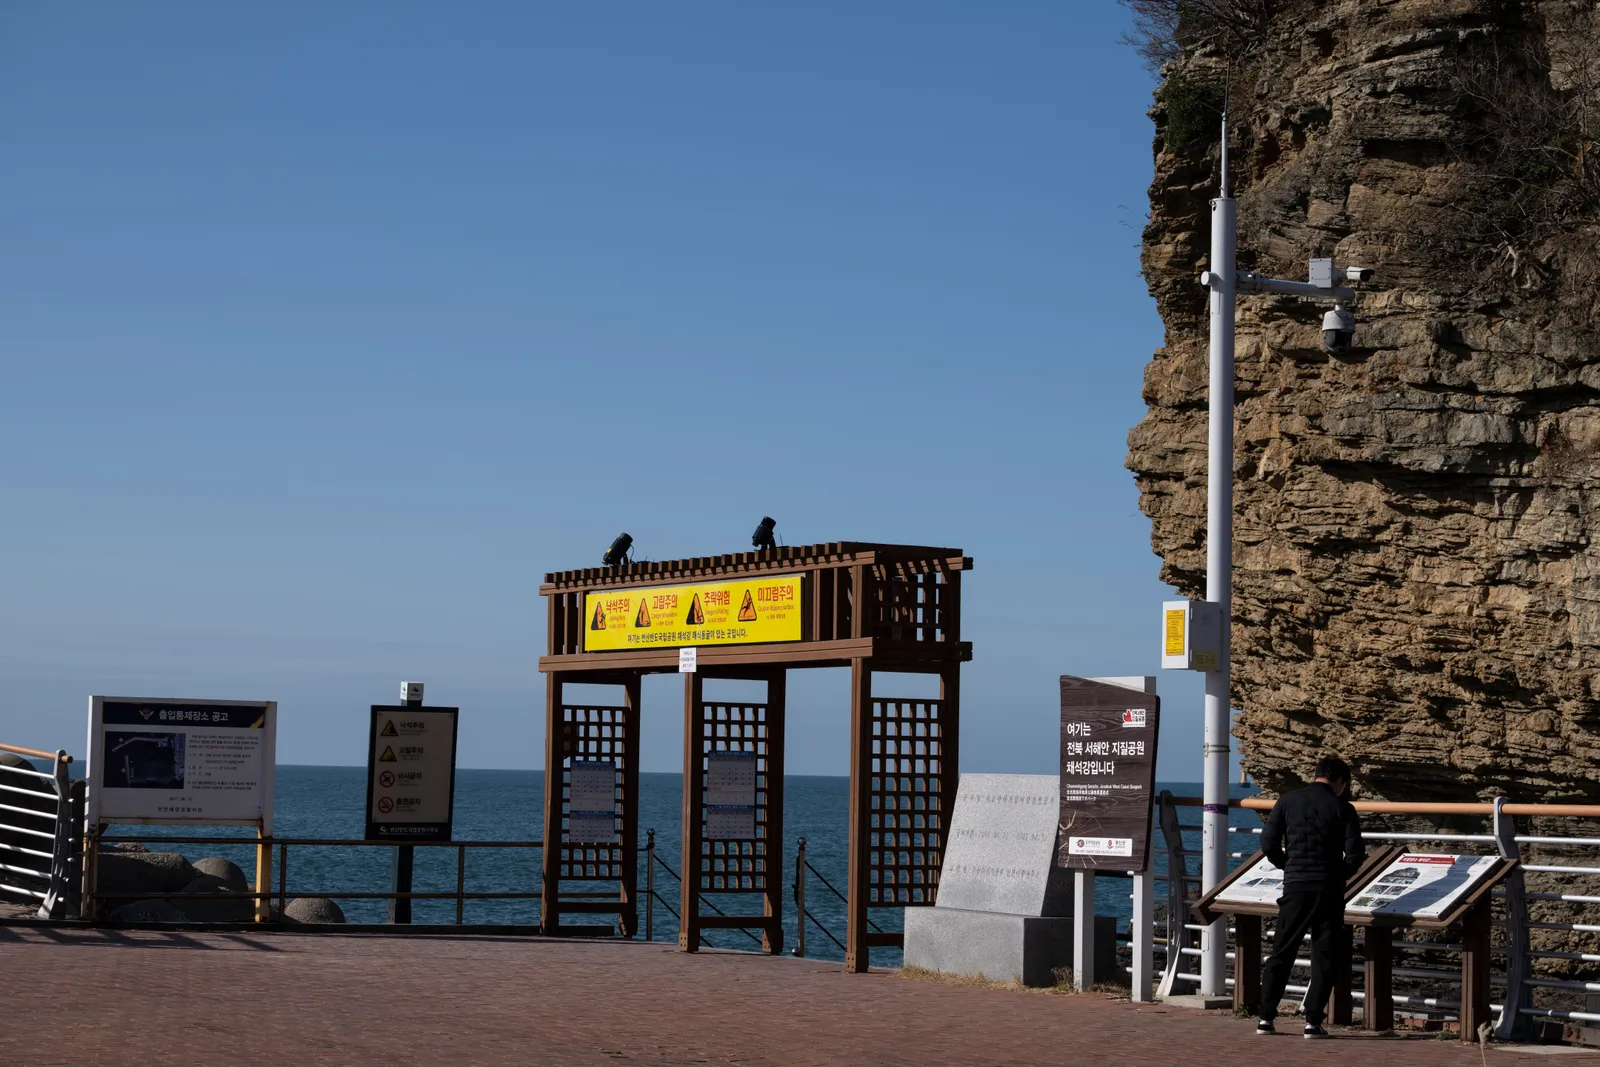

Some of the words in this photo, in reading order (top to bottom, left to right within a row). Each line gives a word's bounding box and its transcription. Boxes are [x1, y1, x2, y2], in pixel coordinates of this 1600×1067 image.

[704, 590, 730, 606] 추락위험
[758, 585, 794, 602] 미끄럼주의
[606, 598, 630, 613] 낙석주의
[652, 594, 678, 610] 고립주의
[642, 632, 676, 643] 변산반도국립공원
[716, 630, 725, 638] 있는
[727, 628, 748, 638] 곳입니다.
[158, 710, 209, 721] 출입통제장소
[212, 712, 228, 722] 공고
[1067, 722, 1091, 736] 여기는
[1067, 742, 1083, 755] 전북
[1085, 742, 1109, 755] 서해안
[1112, 741, 1144, 755] 지질공원
[1066, 761, 1114, 775] 채석강입니다
